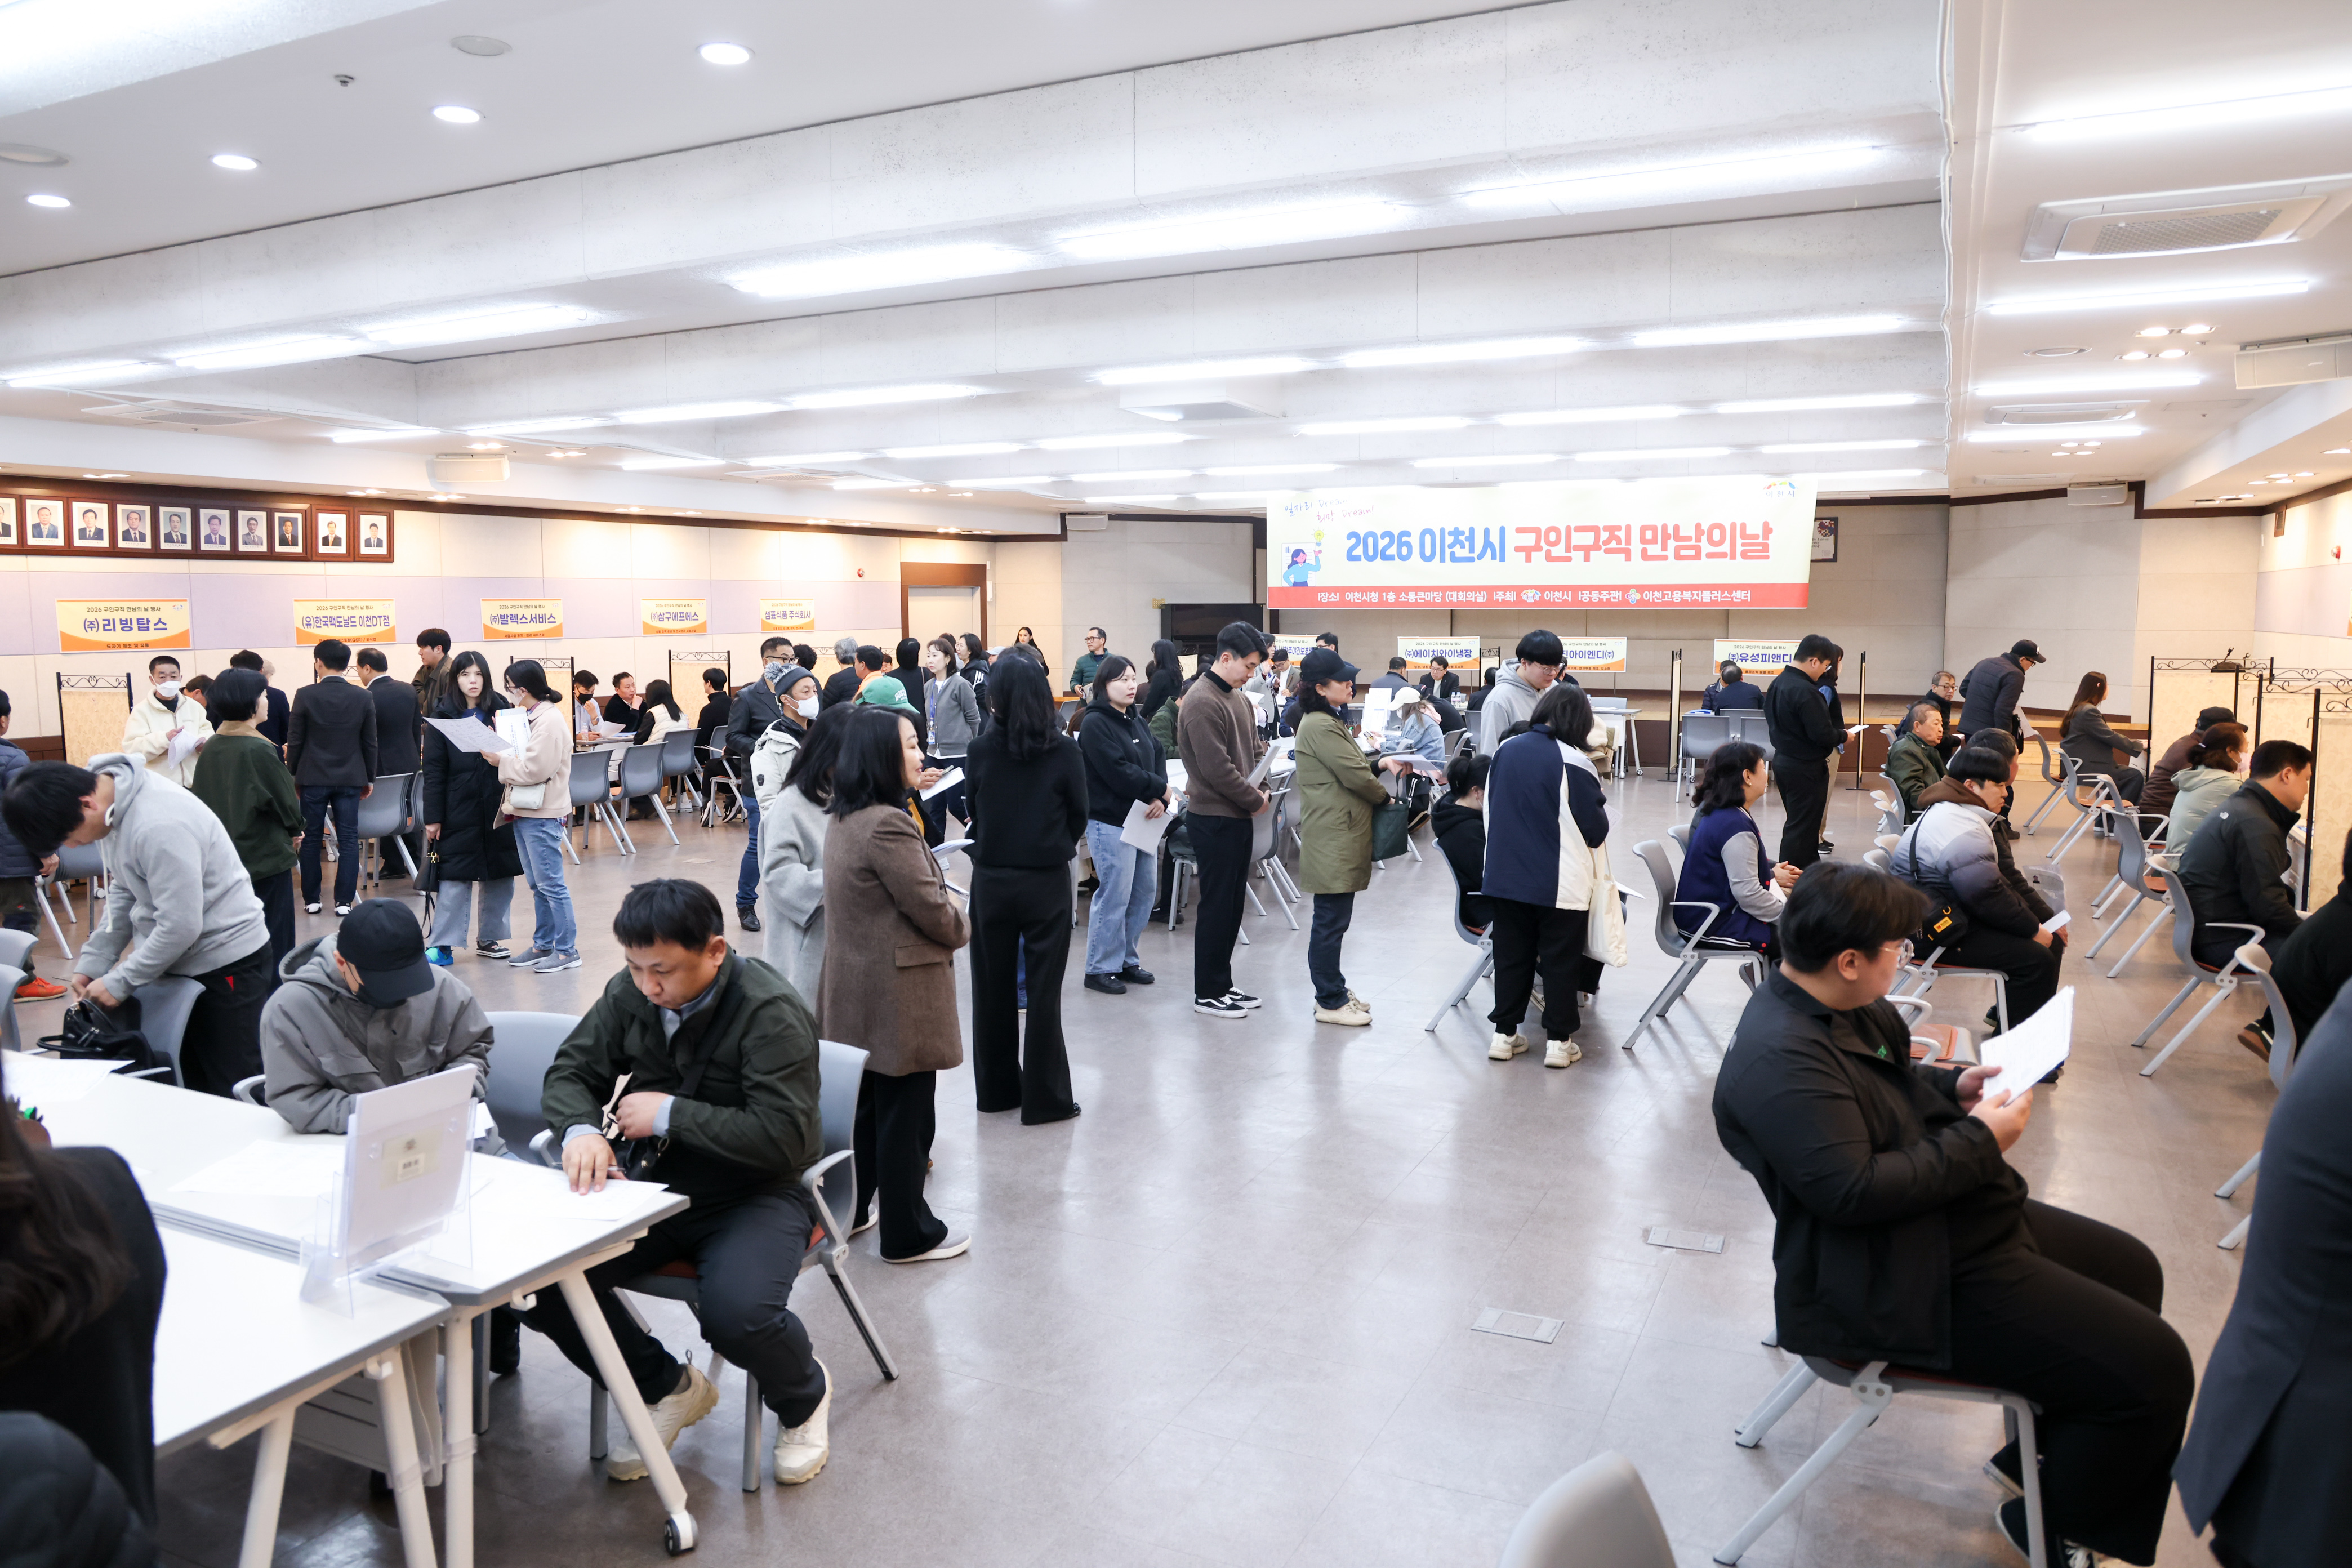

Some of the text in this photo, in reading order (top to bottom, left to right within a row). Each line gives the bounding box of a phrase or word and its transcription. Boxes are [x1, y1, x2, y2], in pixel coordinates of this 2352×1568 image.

[1285, 496, 1350, 517] 일자리 Dream!
[1316, 505, 1374, 523] 희망 Dream!
[1346, 521, 1773, 563] 2026 이천시 구인구직 만남의날
[1345, 591, 1378, 602] 이천시청
[1383, 591, 1396, 602] 1층
[1399, 591, 1442, 602] 소통큰마당
[1445, 591, 1487, 603] (대회의실)
[1544, 591, 1571, 602] 이천시
[1643, 590, 1750, 602] 이천고용복지플러스센터
[302, 615, 390, 629] (유)한국맥도날드 이천DT점
[490, 613, 556, 625] (주)발렉스서비스
[651, 612, 698, 622] (주)삼구에프에스
[765, 611, 811, 620] 샘표식품 주식회사
[84, 618, 167, 632] (주)리빙탑스
[1405, 649, 1472, 658] (주)에이치와이냉장
[1729, 653, 1792, 663] (주)유성피앤디
